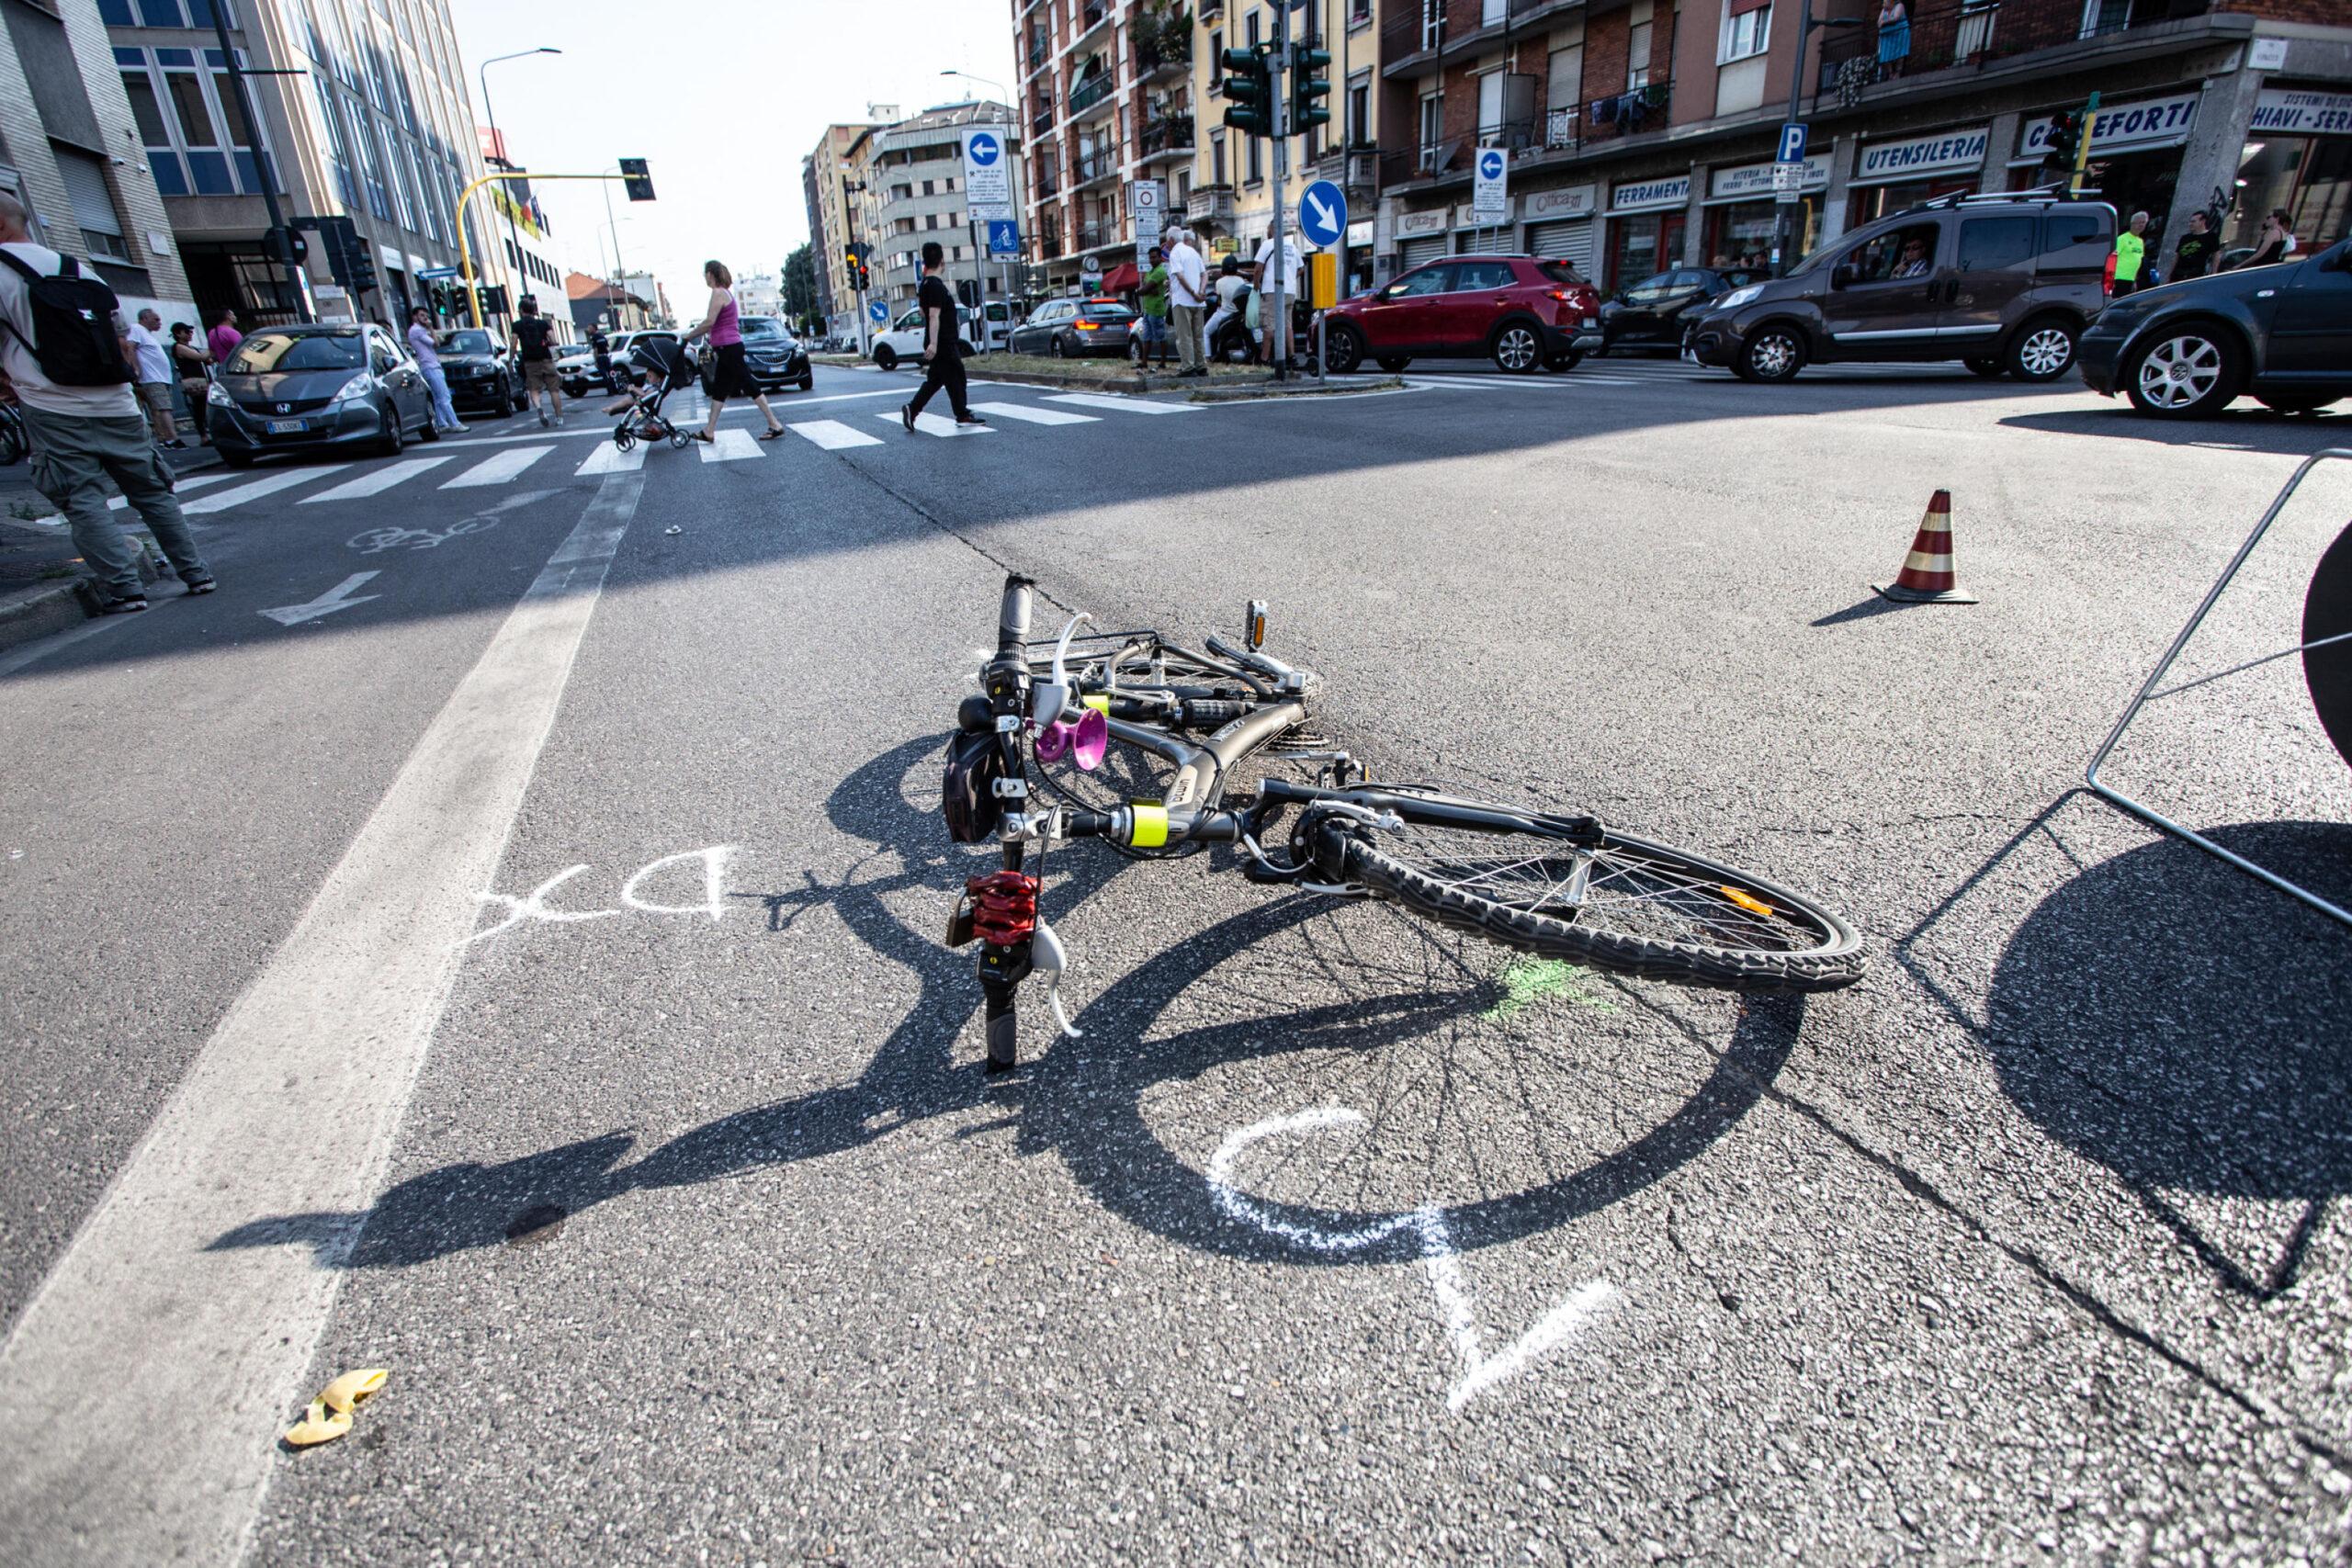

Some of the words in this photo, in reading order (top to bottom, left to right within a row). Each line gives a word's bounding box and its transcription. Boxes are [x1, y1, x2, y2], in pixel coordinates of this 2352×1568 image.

[2284, 94, 2323, 107] SISTEMI
[2251, 107, 2303, 127] HIAVI
[1784, 128, 1803, 160] P
[1866, 134, 1985, 170] UTENSILERIA
